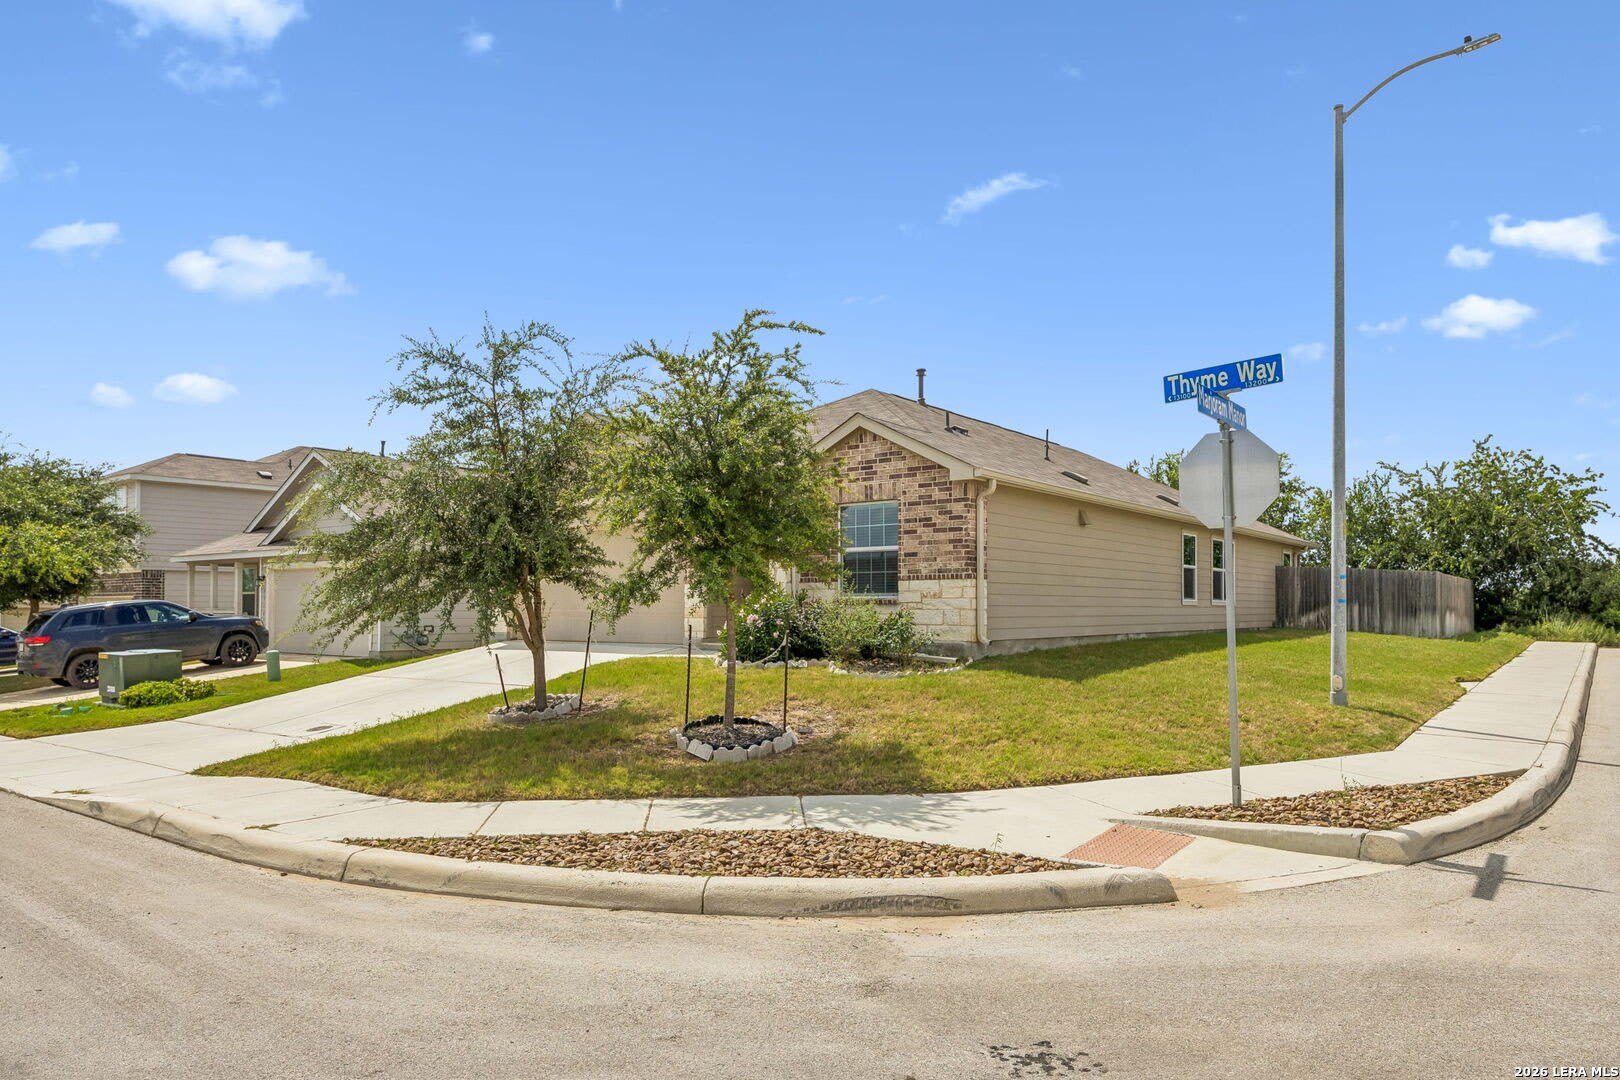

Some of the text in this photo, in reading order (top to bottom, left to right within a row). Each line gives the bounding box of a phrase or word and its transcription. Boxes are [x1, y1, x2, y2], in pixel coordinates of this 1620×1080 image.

[1167, 360, 1277, 395] Thyme Way
[1244, 379, 1268, 388] 13200
